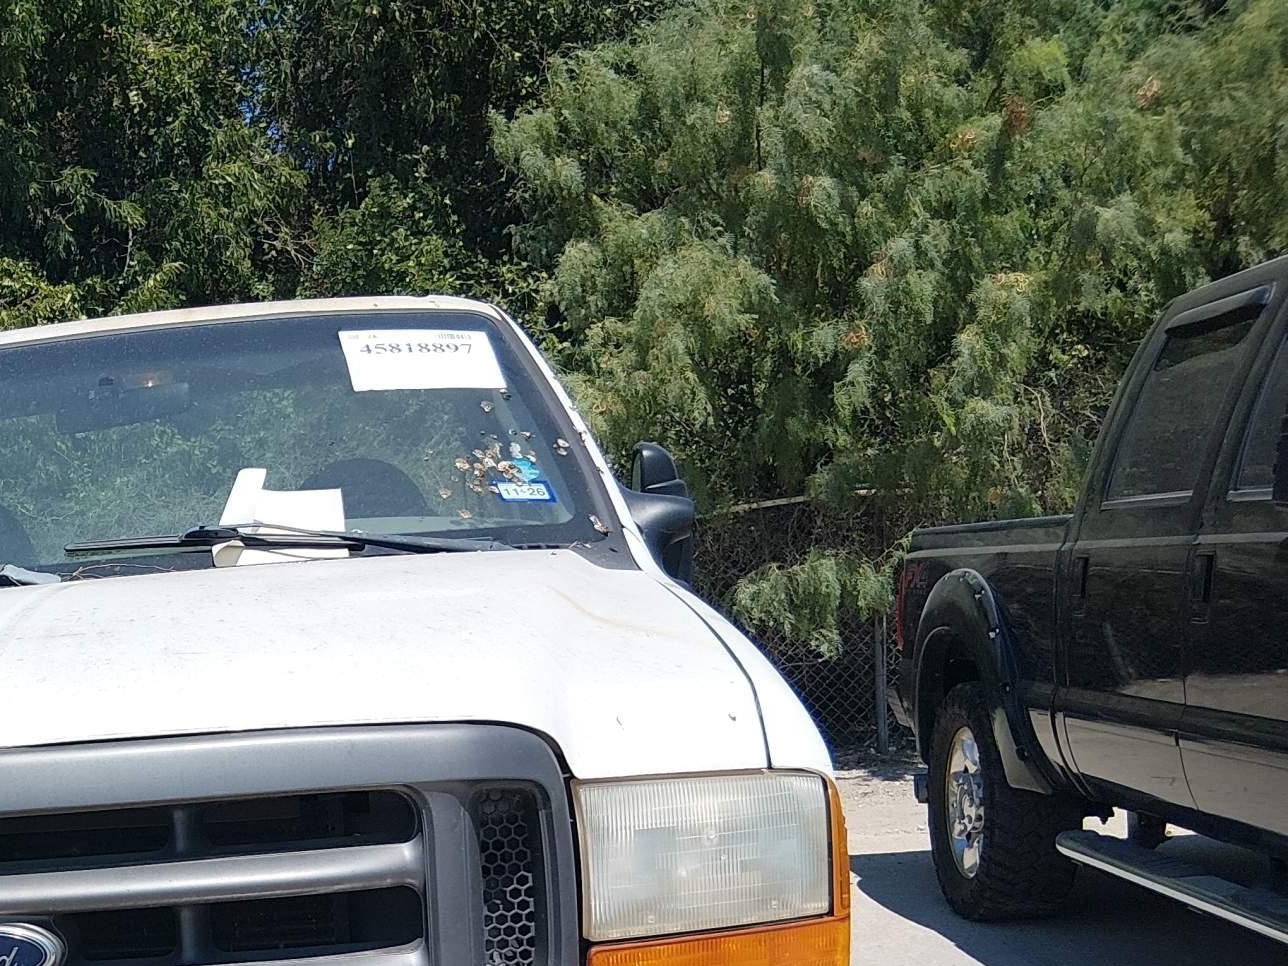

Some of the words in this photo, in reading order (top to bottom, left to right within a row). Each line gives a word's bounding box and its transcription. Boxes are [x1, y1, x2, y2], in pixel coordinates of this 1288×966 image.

[359, 342, 472, 354] 45818897
[503, 487, 520, 496] 11
[527, 487, 546, 497] 26
